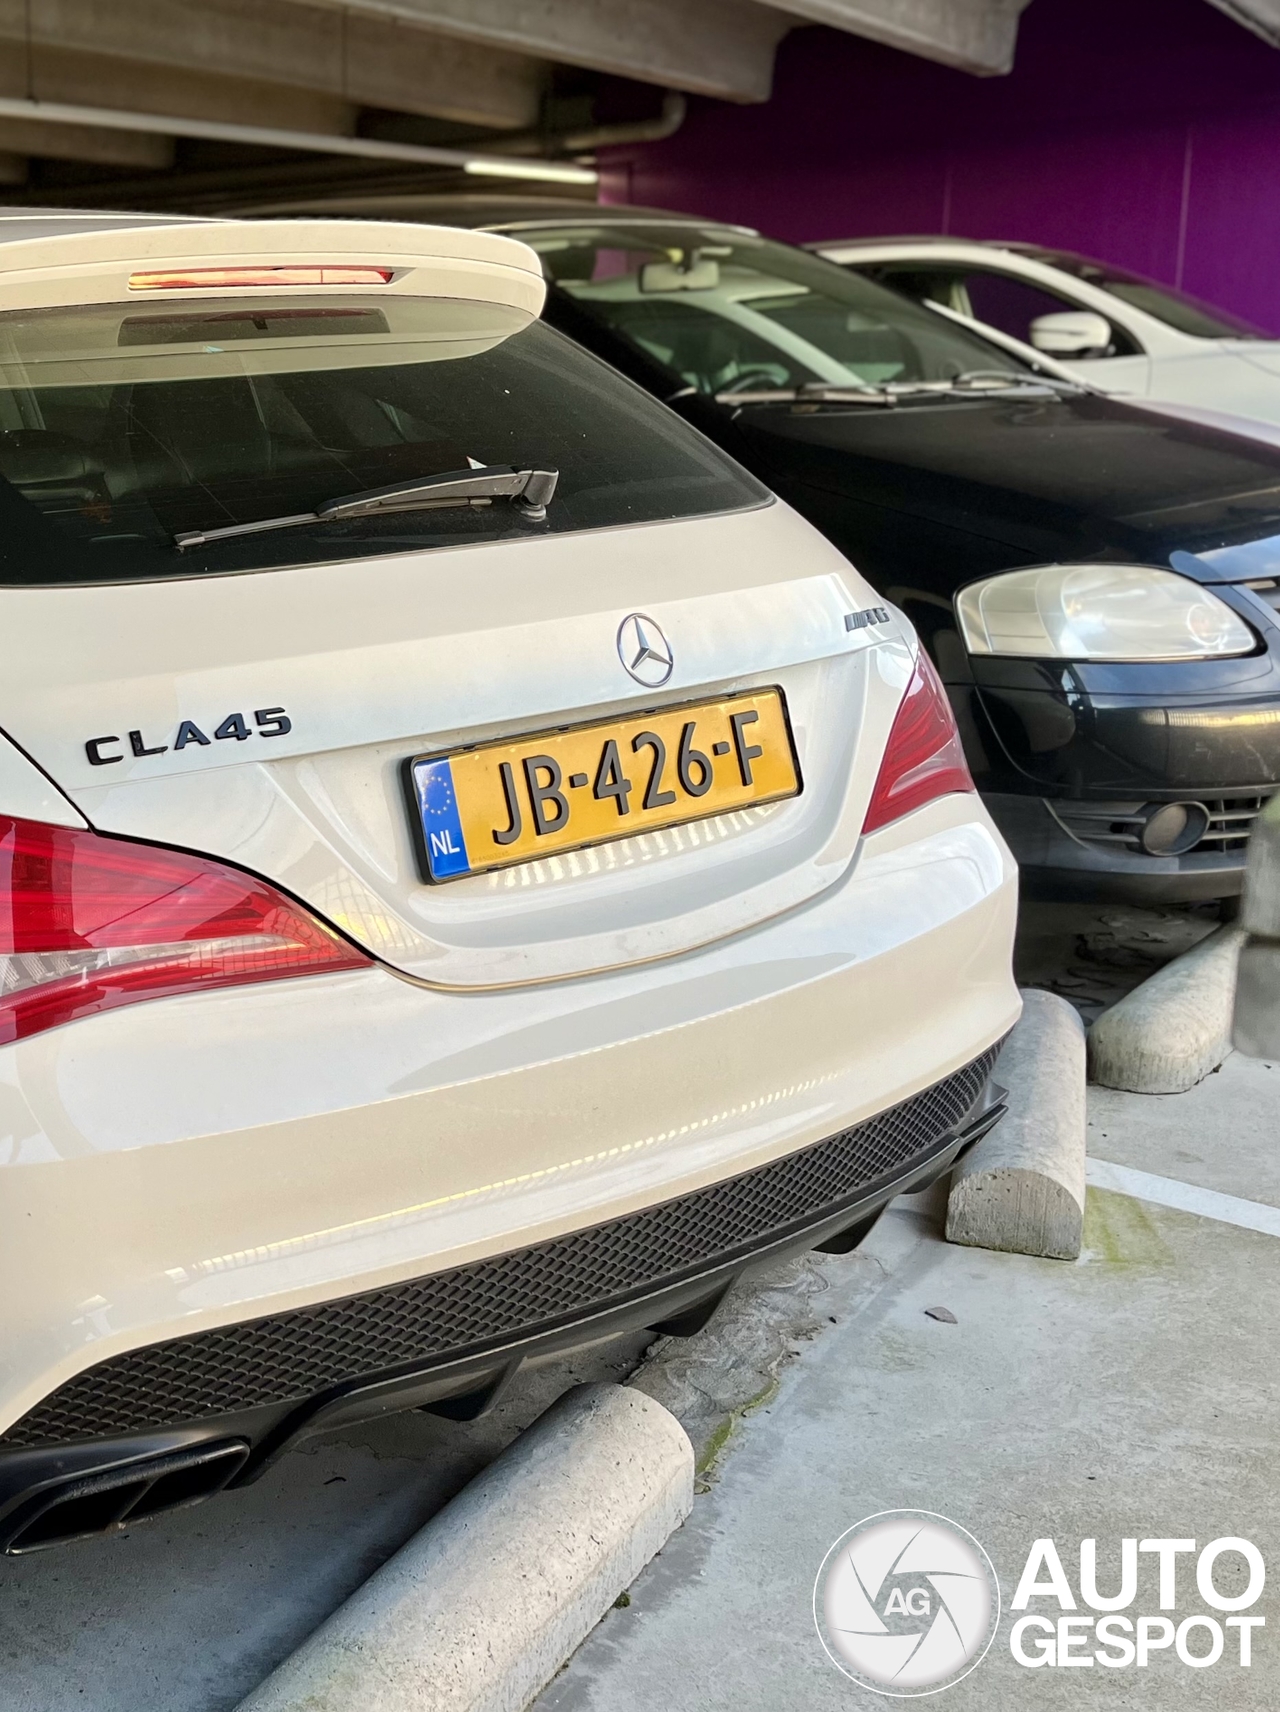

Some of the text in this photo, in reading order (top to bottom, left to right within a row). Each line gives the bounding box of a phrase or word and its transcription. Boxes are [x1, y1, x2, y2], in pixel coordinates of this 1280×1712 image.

[85, 707, 292, 766] CLA45
[491, 710, 763, 845] JB-426-F
[430, 829, 460, 857] NL
